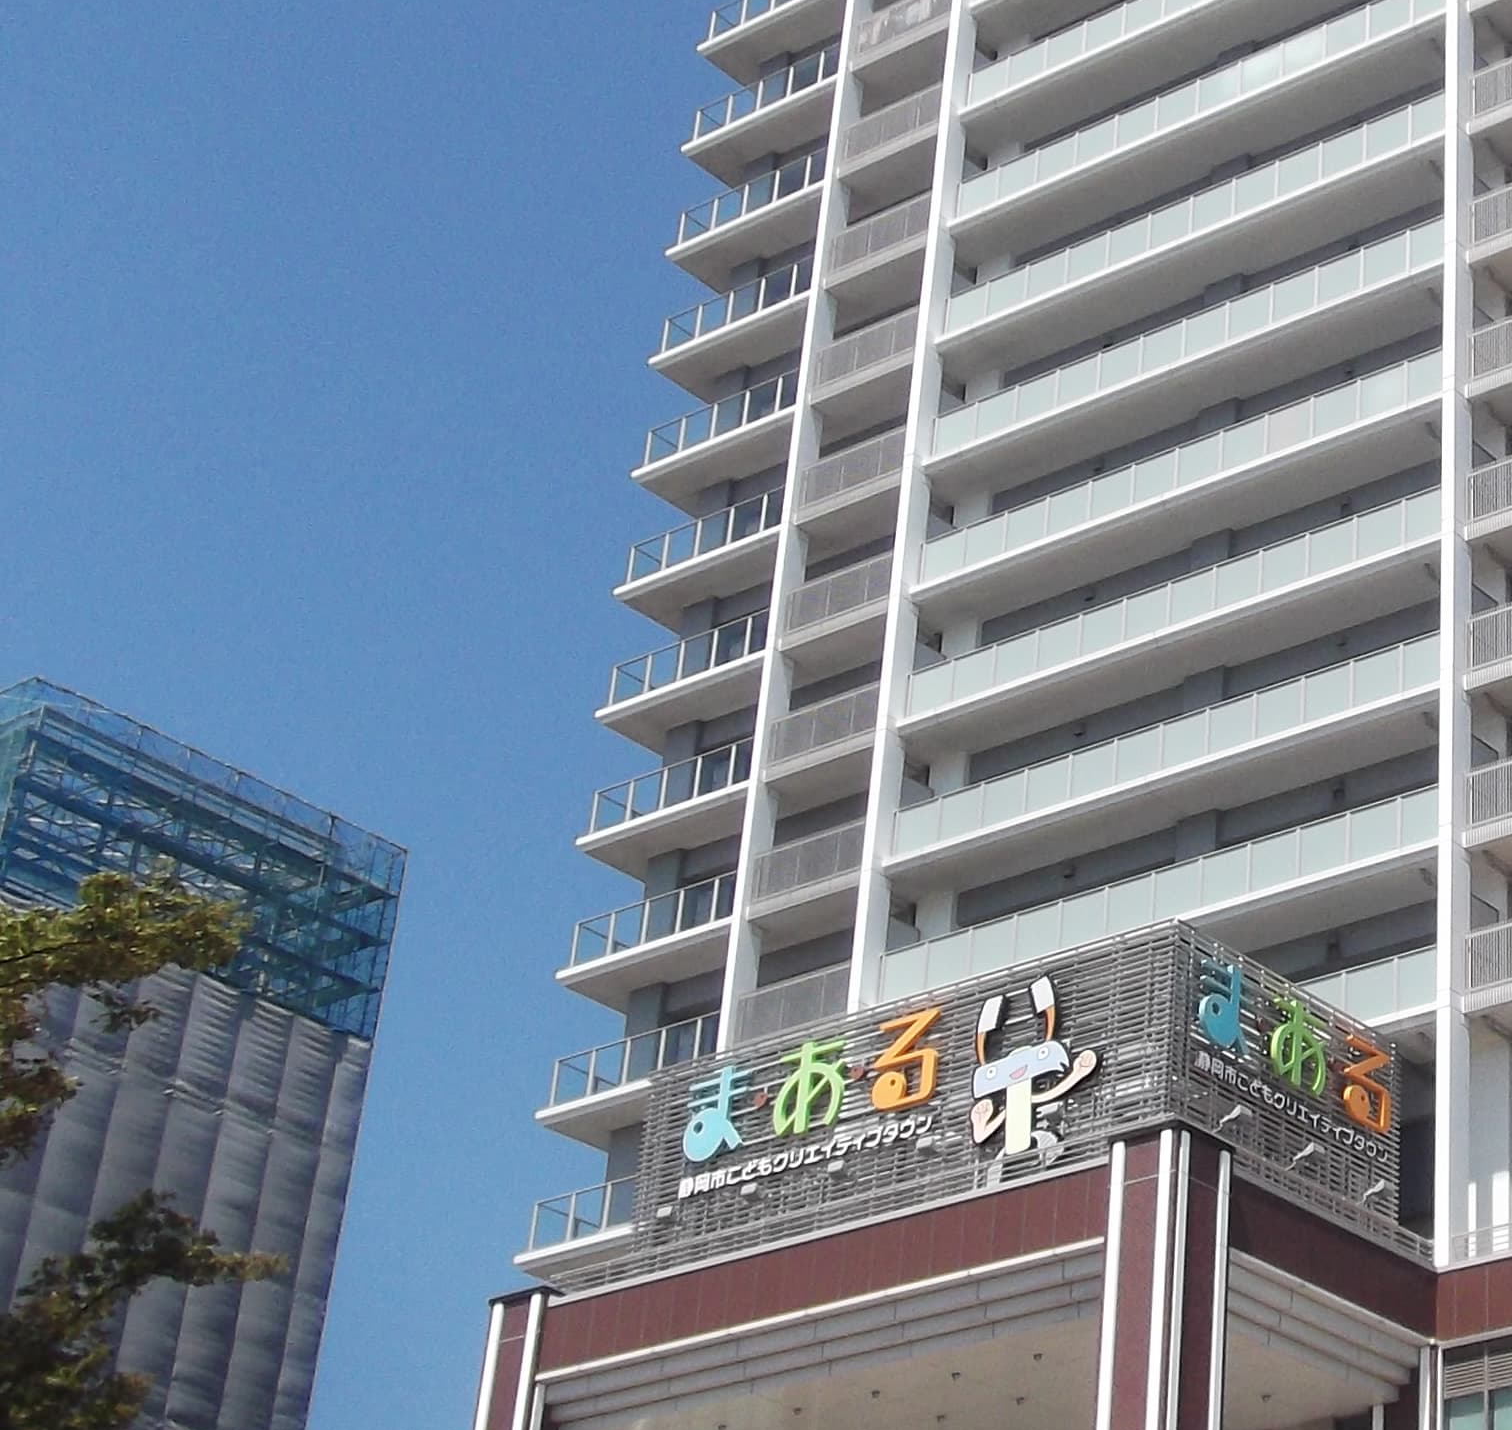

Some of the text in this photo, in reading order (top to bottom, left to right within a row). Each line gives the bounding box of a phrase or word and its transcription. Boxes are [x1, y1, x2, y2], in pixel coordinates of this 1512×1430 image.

[1193, 1051, 1389, 1163] 静岡市こどもクリエイティブタウン
[677, 1114, 934, 1200] 静岡市こどもクリエイティブタウン
